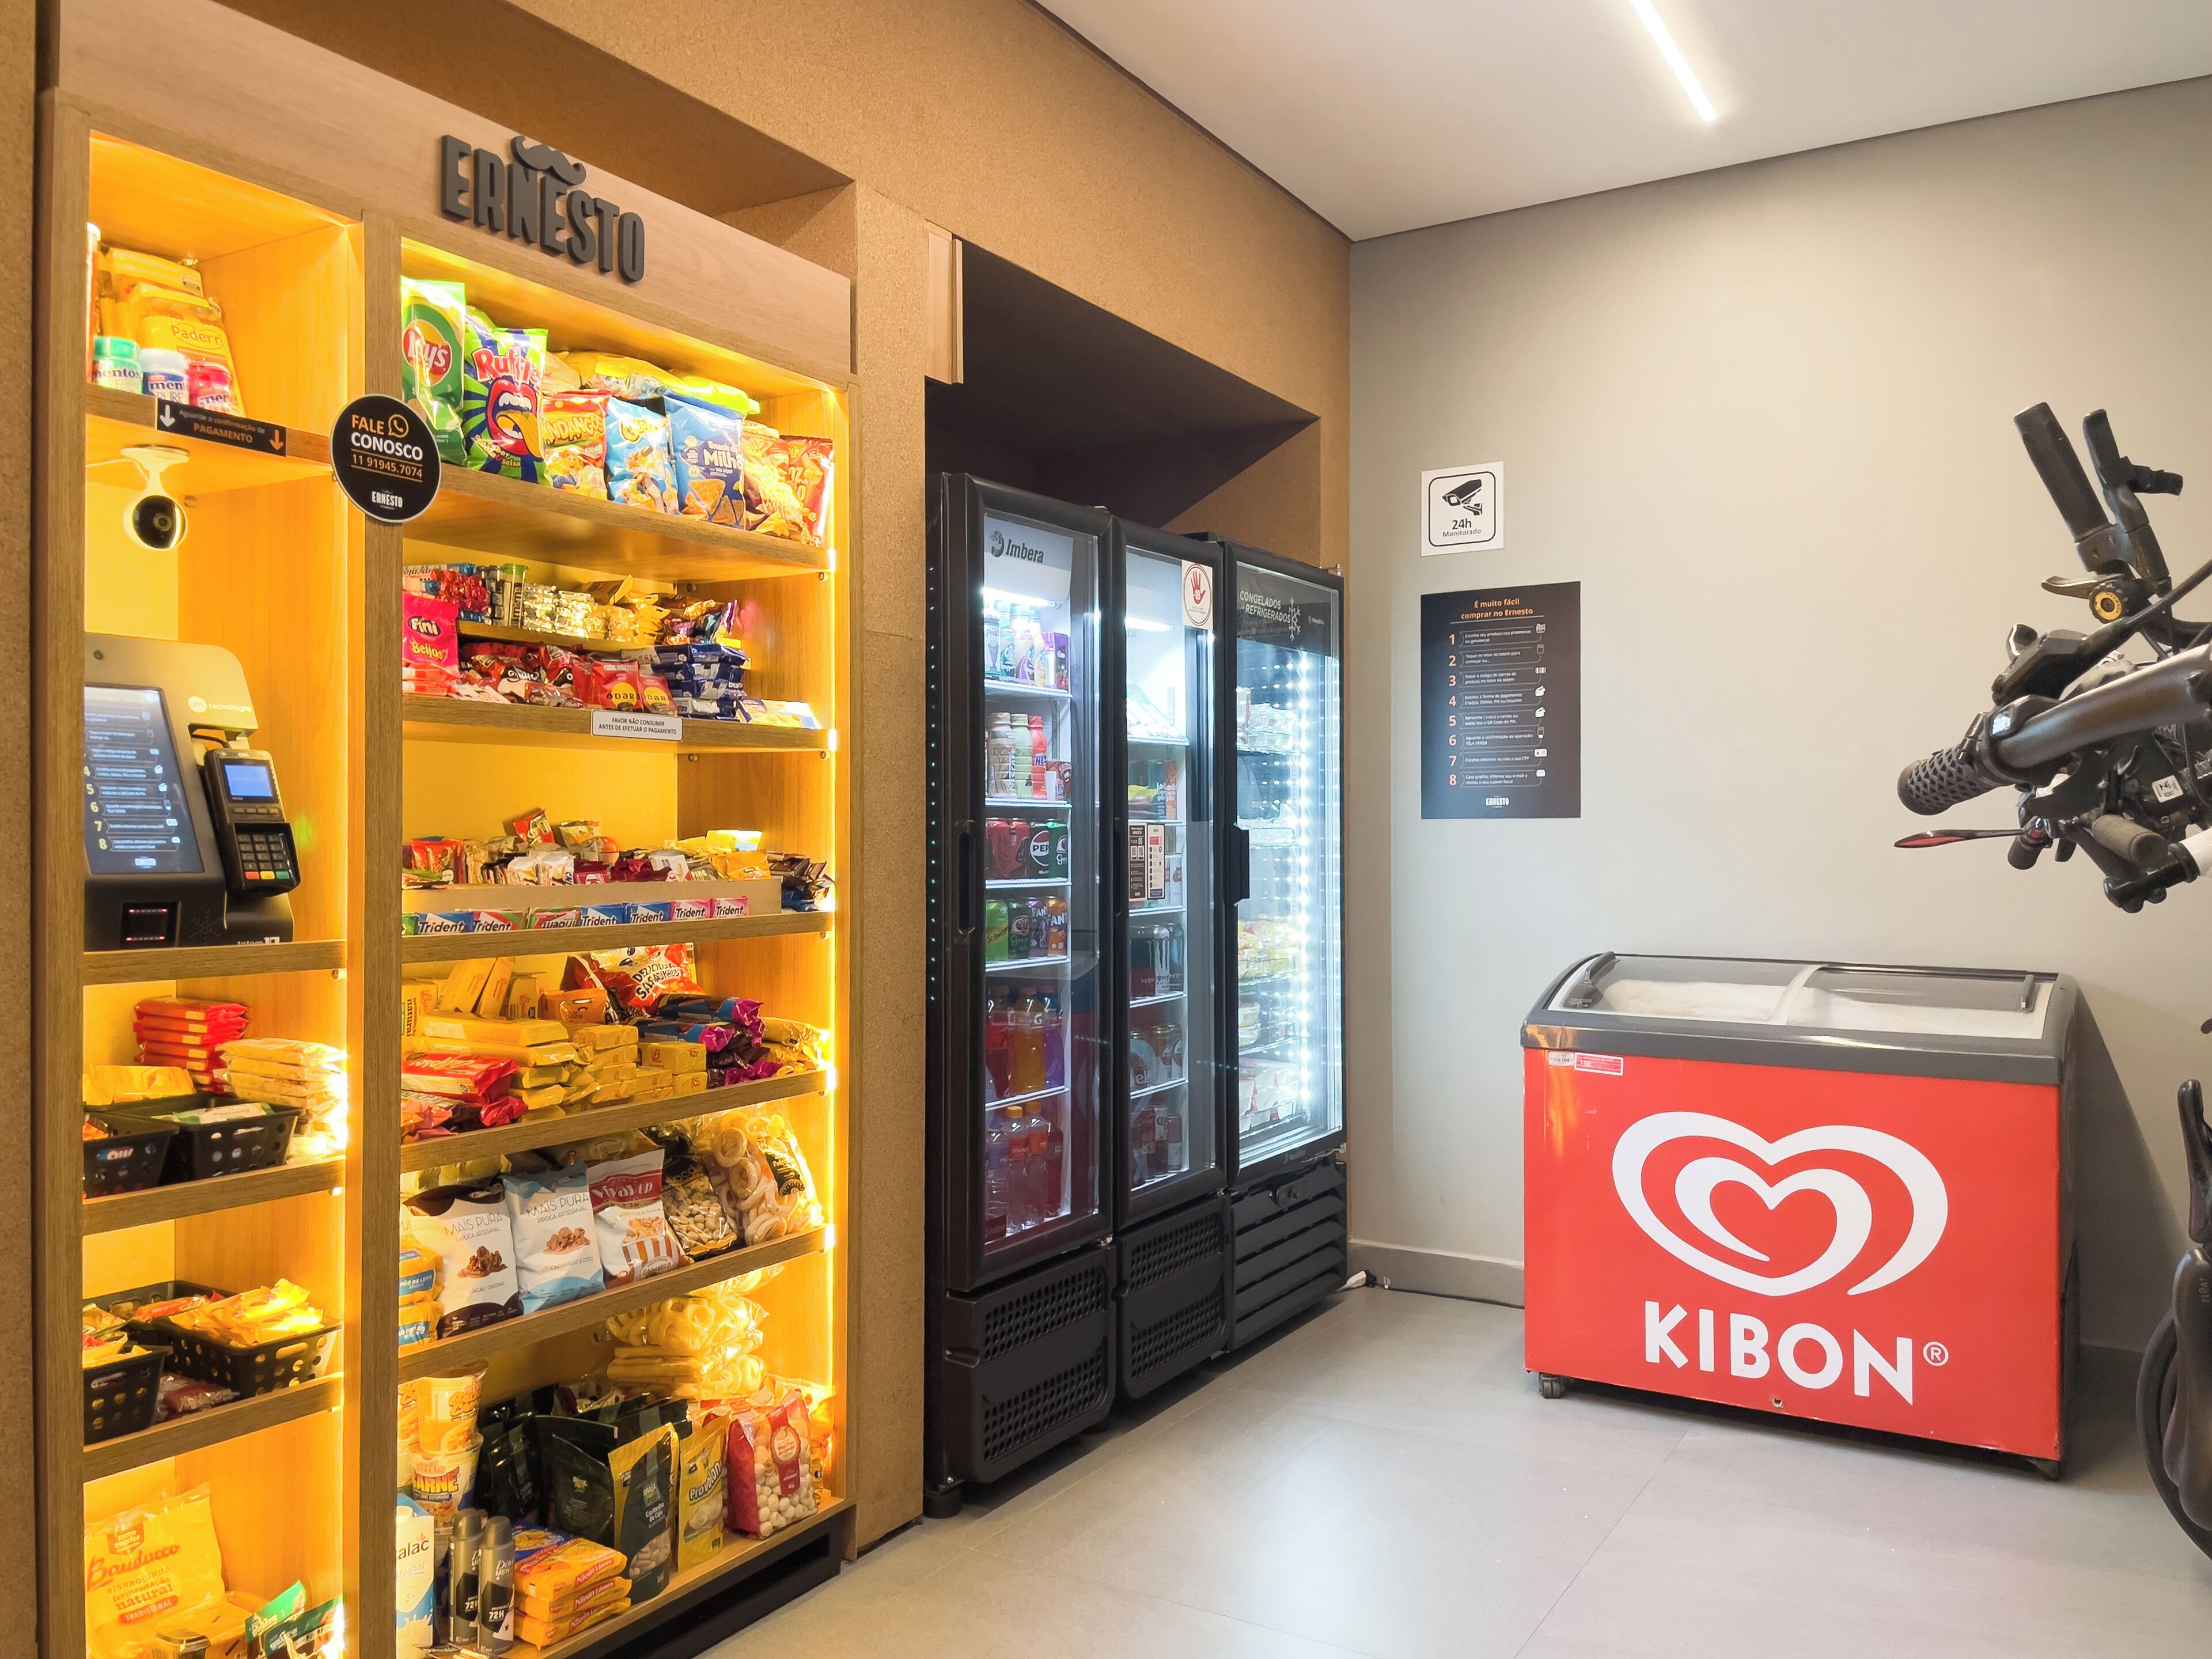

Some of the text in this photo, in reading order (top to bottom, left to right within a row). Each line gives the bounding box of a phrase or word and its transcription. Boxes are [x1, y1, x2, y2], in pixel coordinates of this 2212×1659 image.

[441, 135, 645, 282] ERNESTO
[179, 410, 207, 421] Aguarde
[351, 414, 384, 435] FALE
[543, 415, 605, 445] ANDANGOS
[194, 422, 253, 443] PAGAMENTO
[351, 432, 423, 461] CONOSCO
[703, 448, 744, 471] Milho
[353, 454, 422, 478] 11 91945.7074
[372, 491, 403, 508] ERNESTO
[1452, 518, 1472, 530] 24h
[1442, 528, 1482, 537] Monitorado
[1006, 539, 1044, 563] Imbera
[1240, 590, 1281, 609] CONGELADOS
[1474, 598, 1520, 608] É muito fácil
[1245, 604, 1290, 623] REFRIGERADOS
[1461, 612, 1492, 620] comprar
[411, 616, 440, 635] Fini
[1449, 634, 1455, 645] 1
[1449, 655, 1456, 666] 2
[1449, 675, 1456, 687] 3
[1448, 695, 1456, 706] 4
[208, 703, 252, 713] tecnologia
[1449, 715, 1456, 726] 5
[1449, 734, 1456, 746] 6
[1449, 756, 1456, 767] 7
[1449, 774, 1456, 786] 8
[1486, 797, 1509, 806] ERNESTO
[676, 908, 706, 918] Trident
[716, 906, 744, 916] Trident
[582, 915, 616, 926] Trident
[632, 913, 664, 923] Trident
[419, 921, 461, 933] Trident
[474, 921, 511, 932] Trident
[559, 1192, 590, 1209] PURA
[475, 1212, 503, 1228] PURA
[690, 1459, 723, 1501] Provolon
[397, 1540, 429, 1561] alac
[87, 1544, 181, 1593] Bauducco
[116, 1584, 173, 1611] natural
